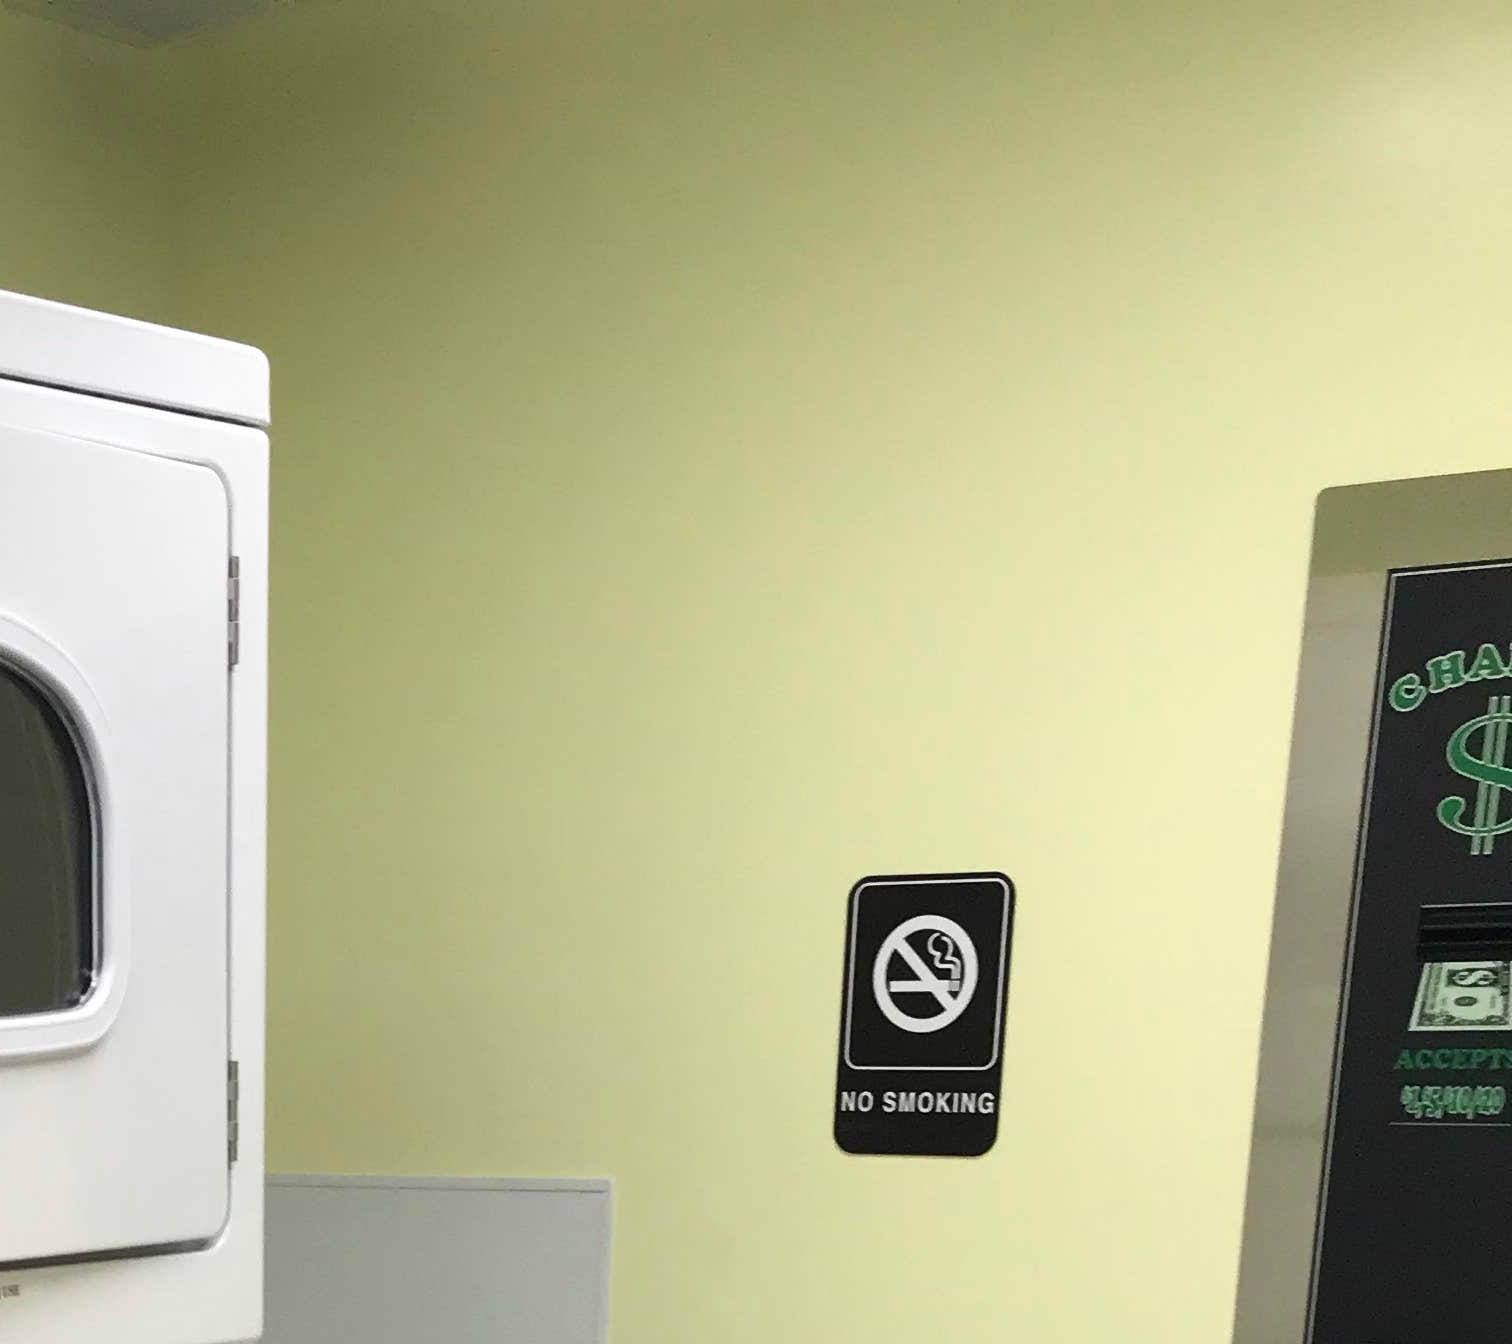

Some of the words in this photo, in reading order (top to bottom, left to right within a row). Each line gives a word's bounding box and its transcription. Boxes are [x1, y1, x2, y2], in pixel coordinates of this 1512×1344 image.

[1389, 643, 1512, 712] CHA
[841, 1091, 874, 1113] NO
[882, 1092, 995, 1114] SMOKING
